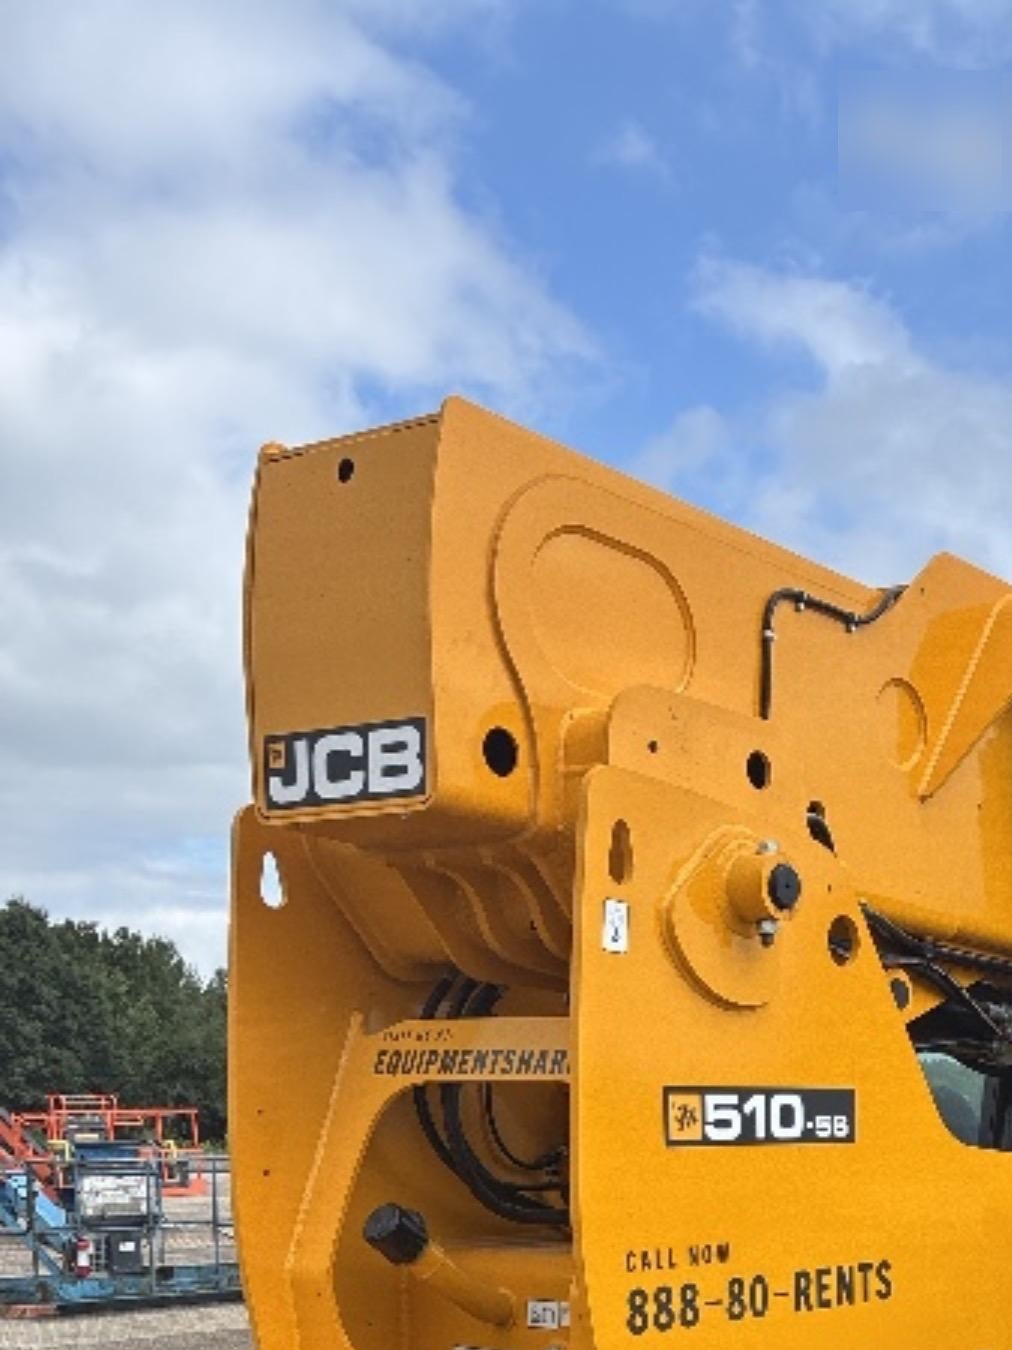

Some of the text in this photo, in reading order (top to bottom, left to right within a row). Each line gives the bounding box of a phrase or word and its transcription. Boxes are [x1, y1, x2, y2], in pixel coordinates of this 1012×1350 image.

[269, 725, 423, 804] JCB
[625, 1241, 730, 1273] CALL NOW
[626, 1259, 893, 1336] 888-80-RENTS
